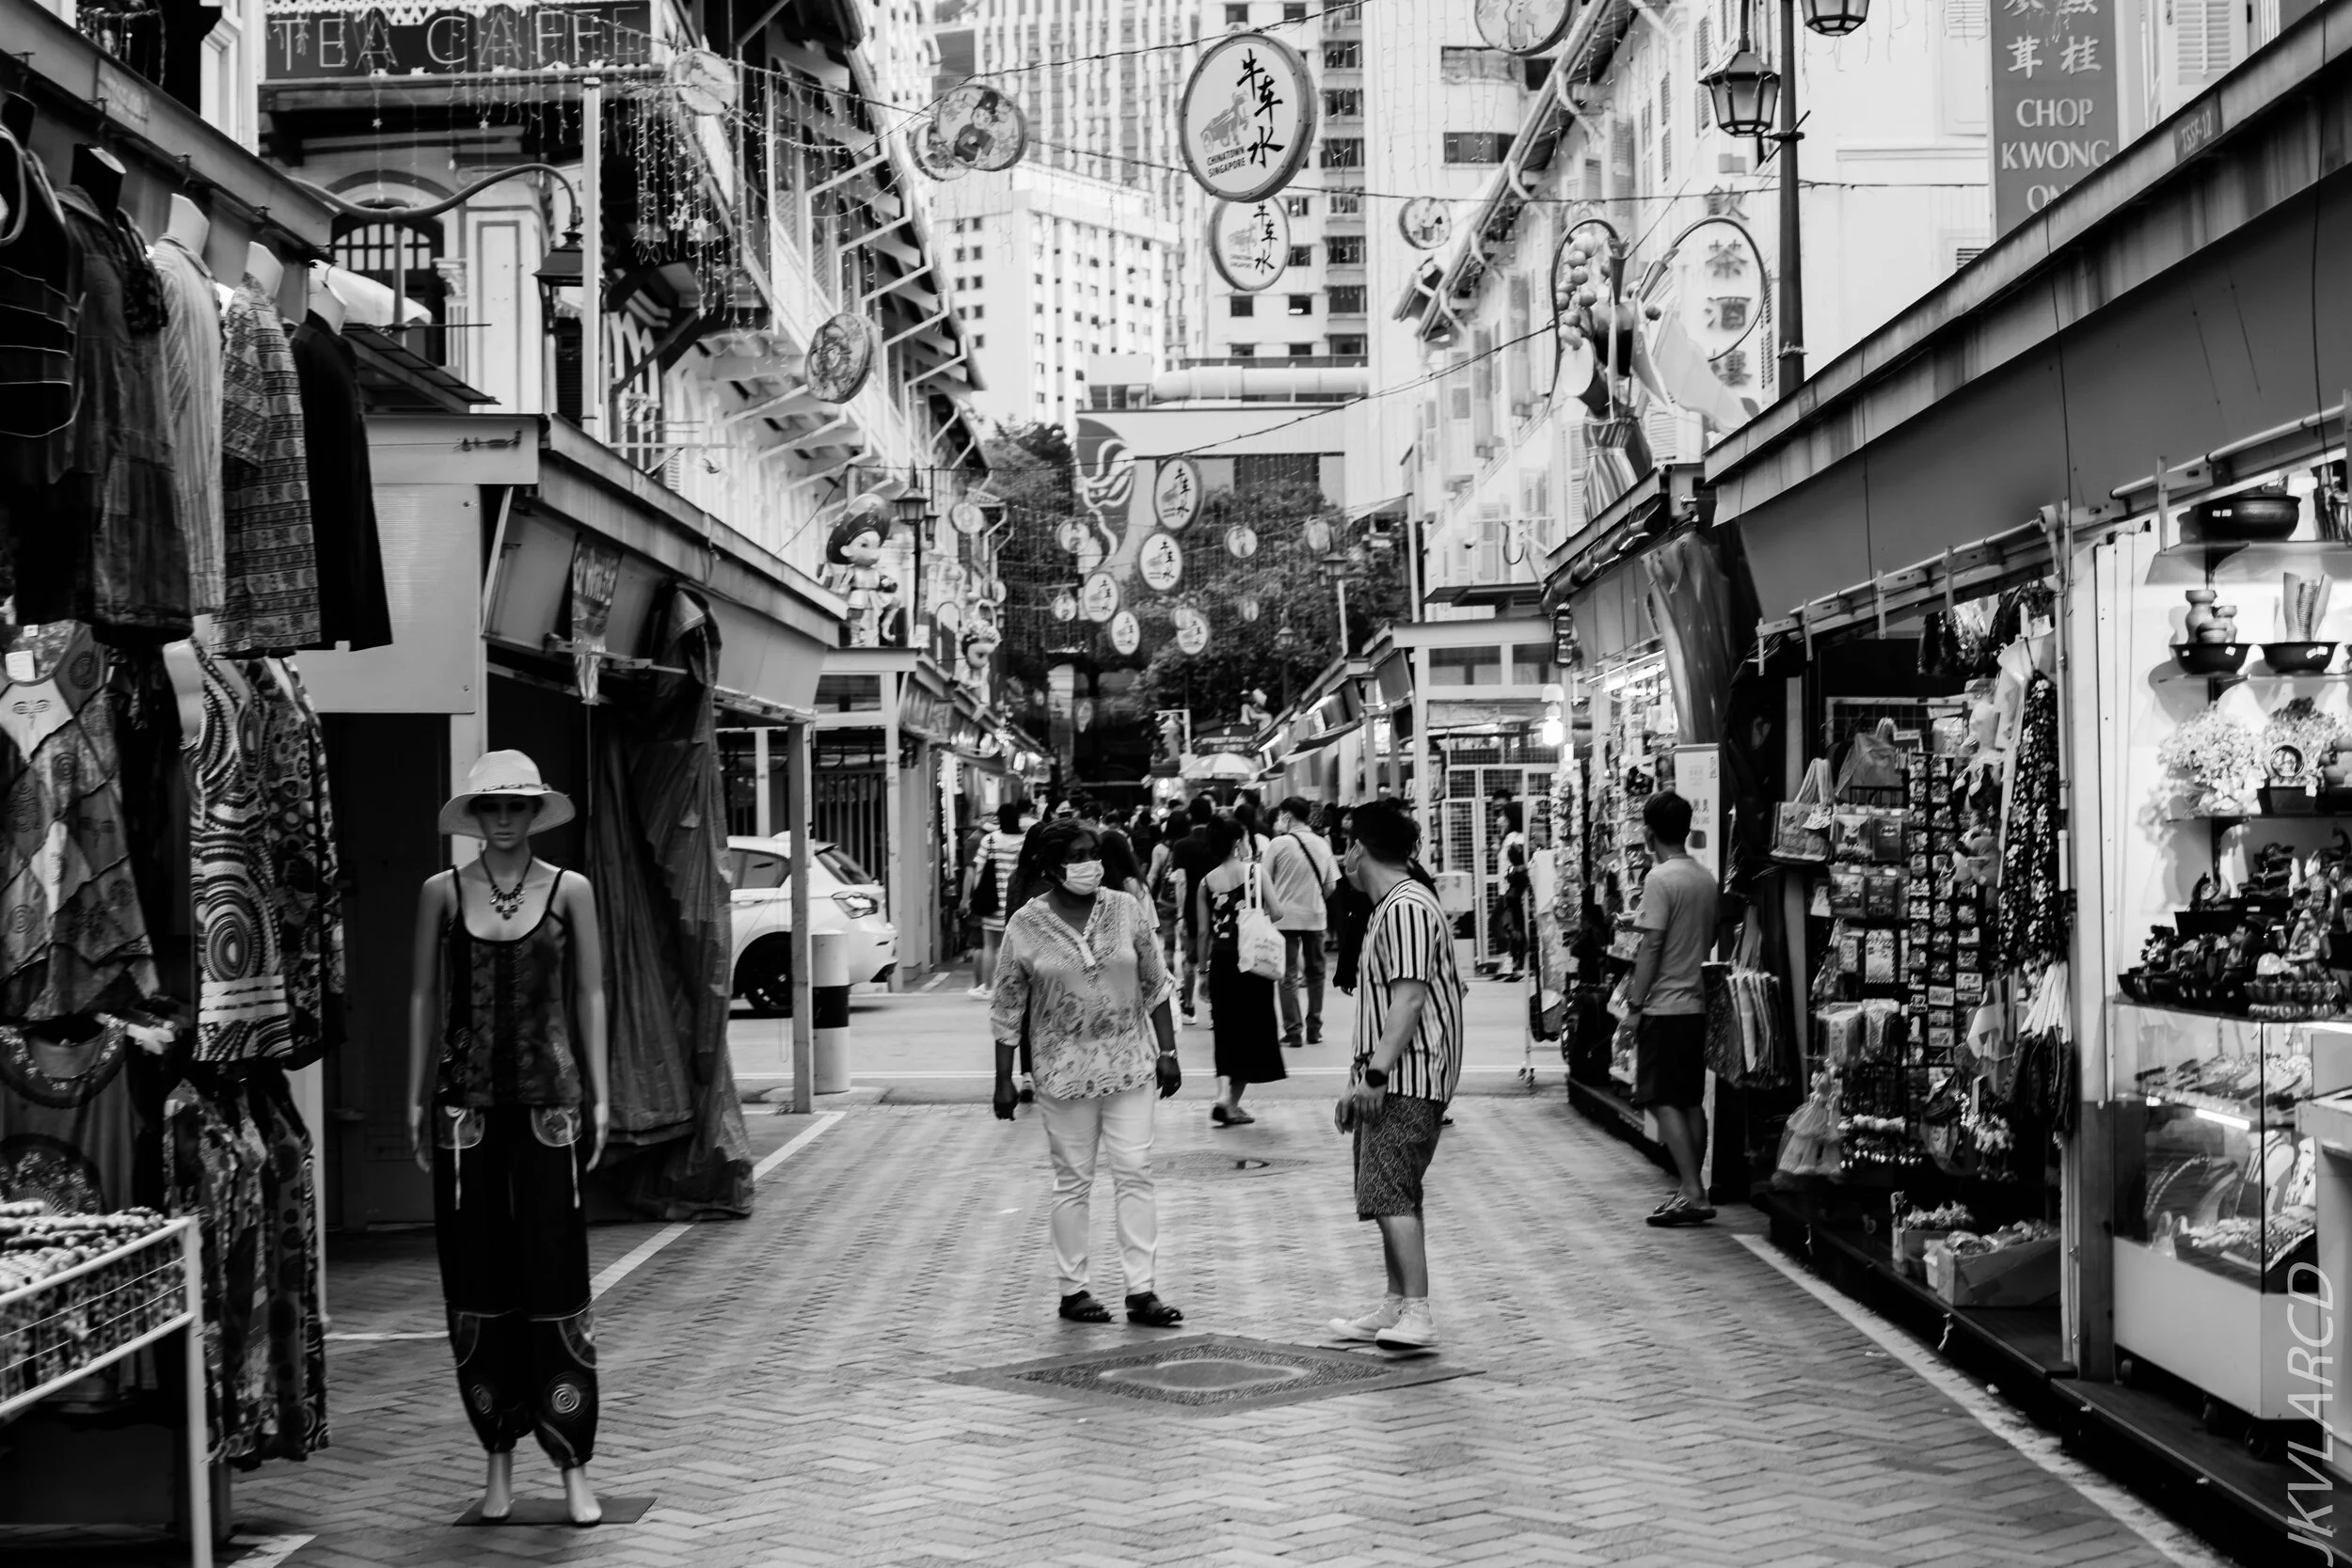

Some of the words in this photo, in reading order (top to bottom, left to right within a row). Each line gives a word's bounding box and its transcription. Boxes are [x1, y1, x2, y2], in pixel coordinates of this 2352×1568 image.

[271, 16, 398, 71] TEA
[427, 7, 641, 65] CAFFE
[1236, 48, 1285, 168] 牛车水
[2016, 98, 2093, 128] CHOP
[1207, 146, 1245, 166] CHINATOWN
[1208, 157, 1246, 178] SINGAPORE
[2001, 140, 2111, 169] KWONG
